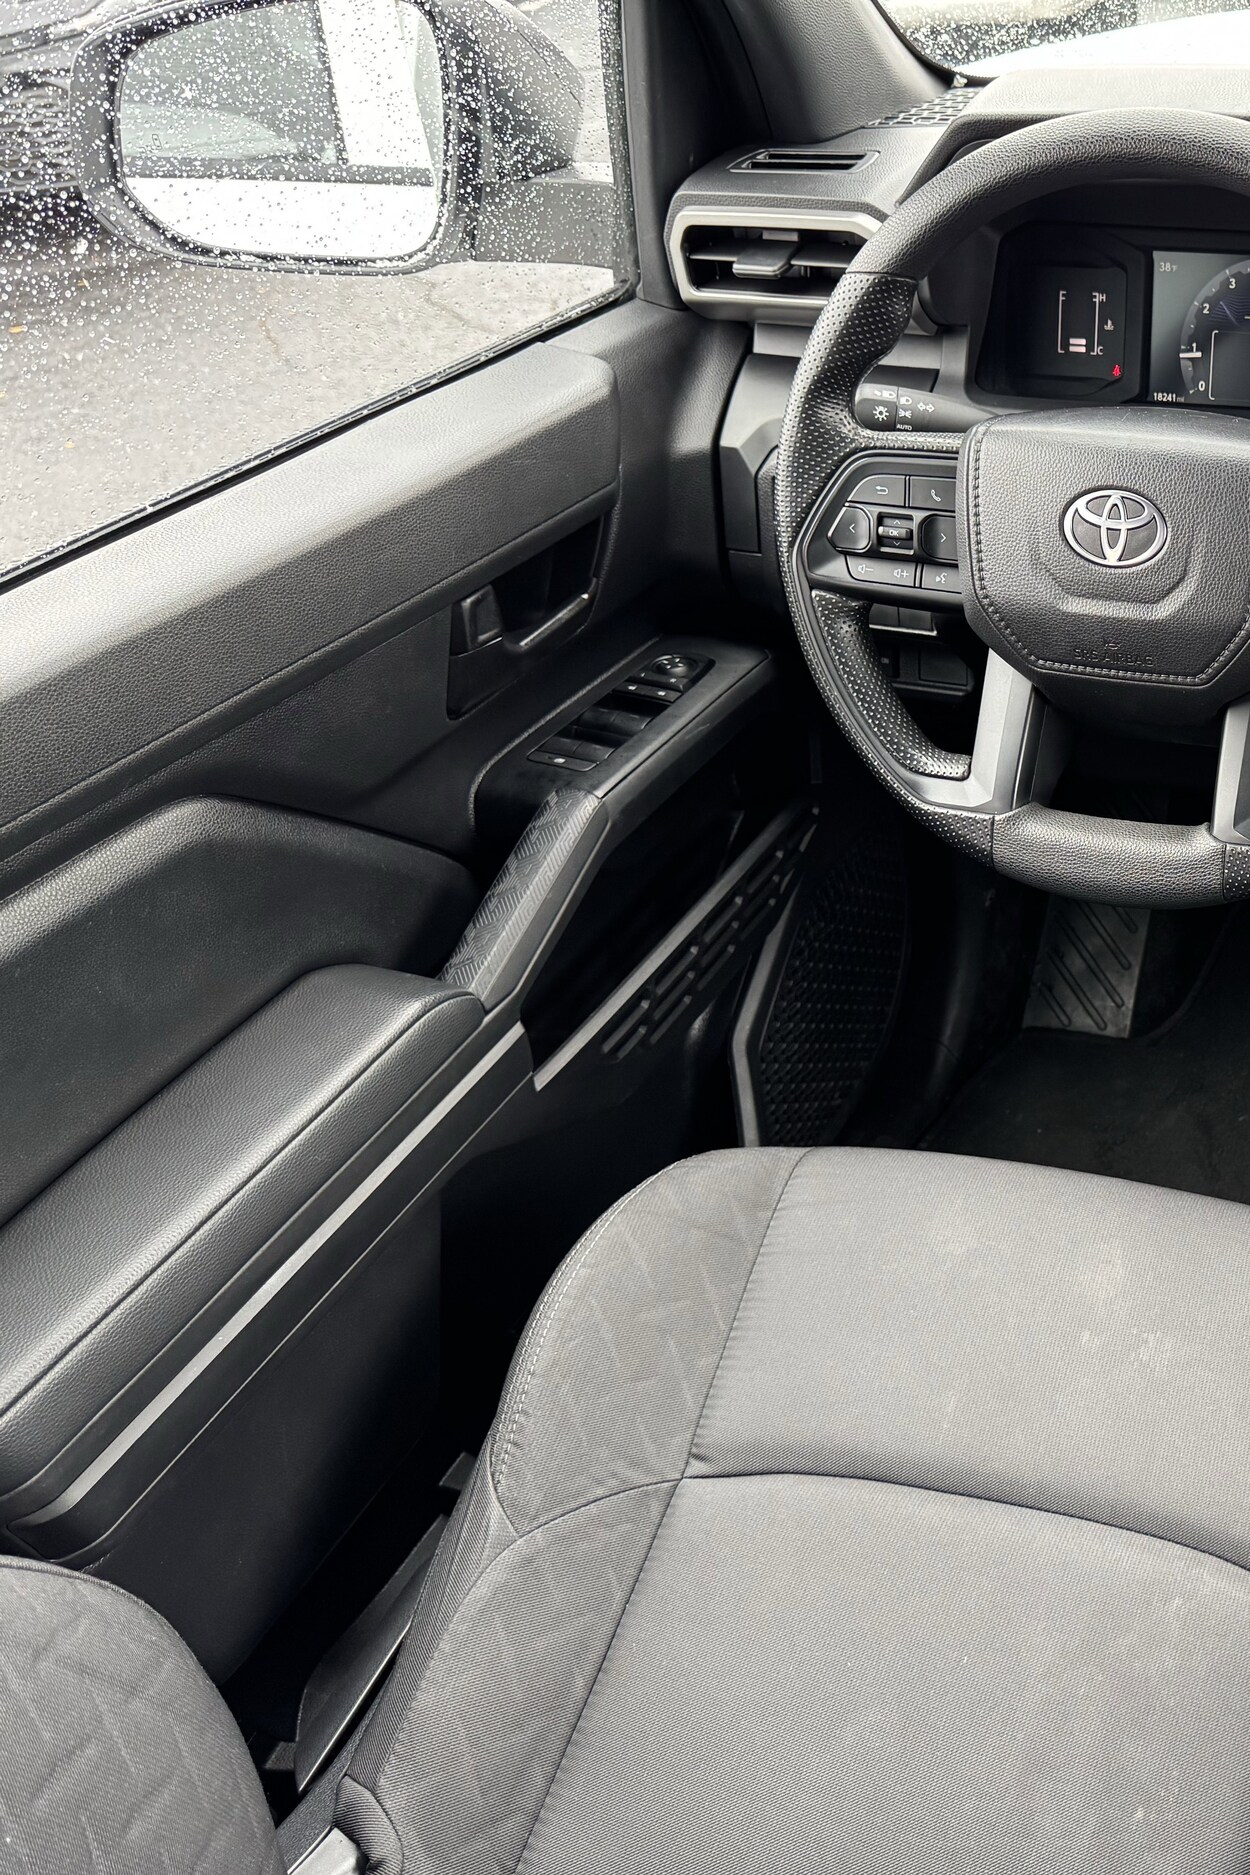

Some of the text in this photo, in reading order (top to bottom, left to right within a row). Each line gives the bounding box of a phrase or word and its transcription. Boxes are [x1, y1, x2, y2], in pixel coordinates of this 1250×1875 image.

[1229, 278, 1236, 289] 3
[1099, 293, 1106, 302] H
[1202, 303, 1210, 314] 2
[1097, 346, 1104, 355] C
[1191, 342, 1197, 352] 1
[1198, 381, 1206, 391] 0
[1074, 649, 1154, 667] SRS AIRBAG
